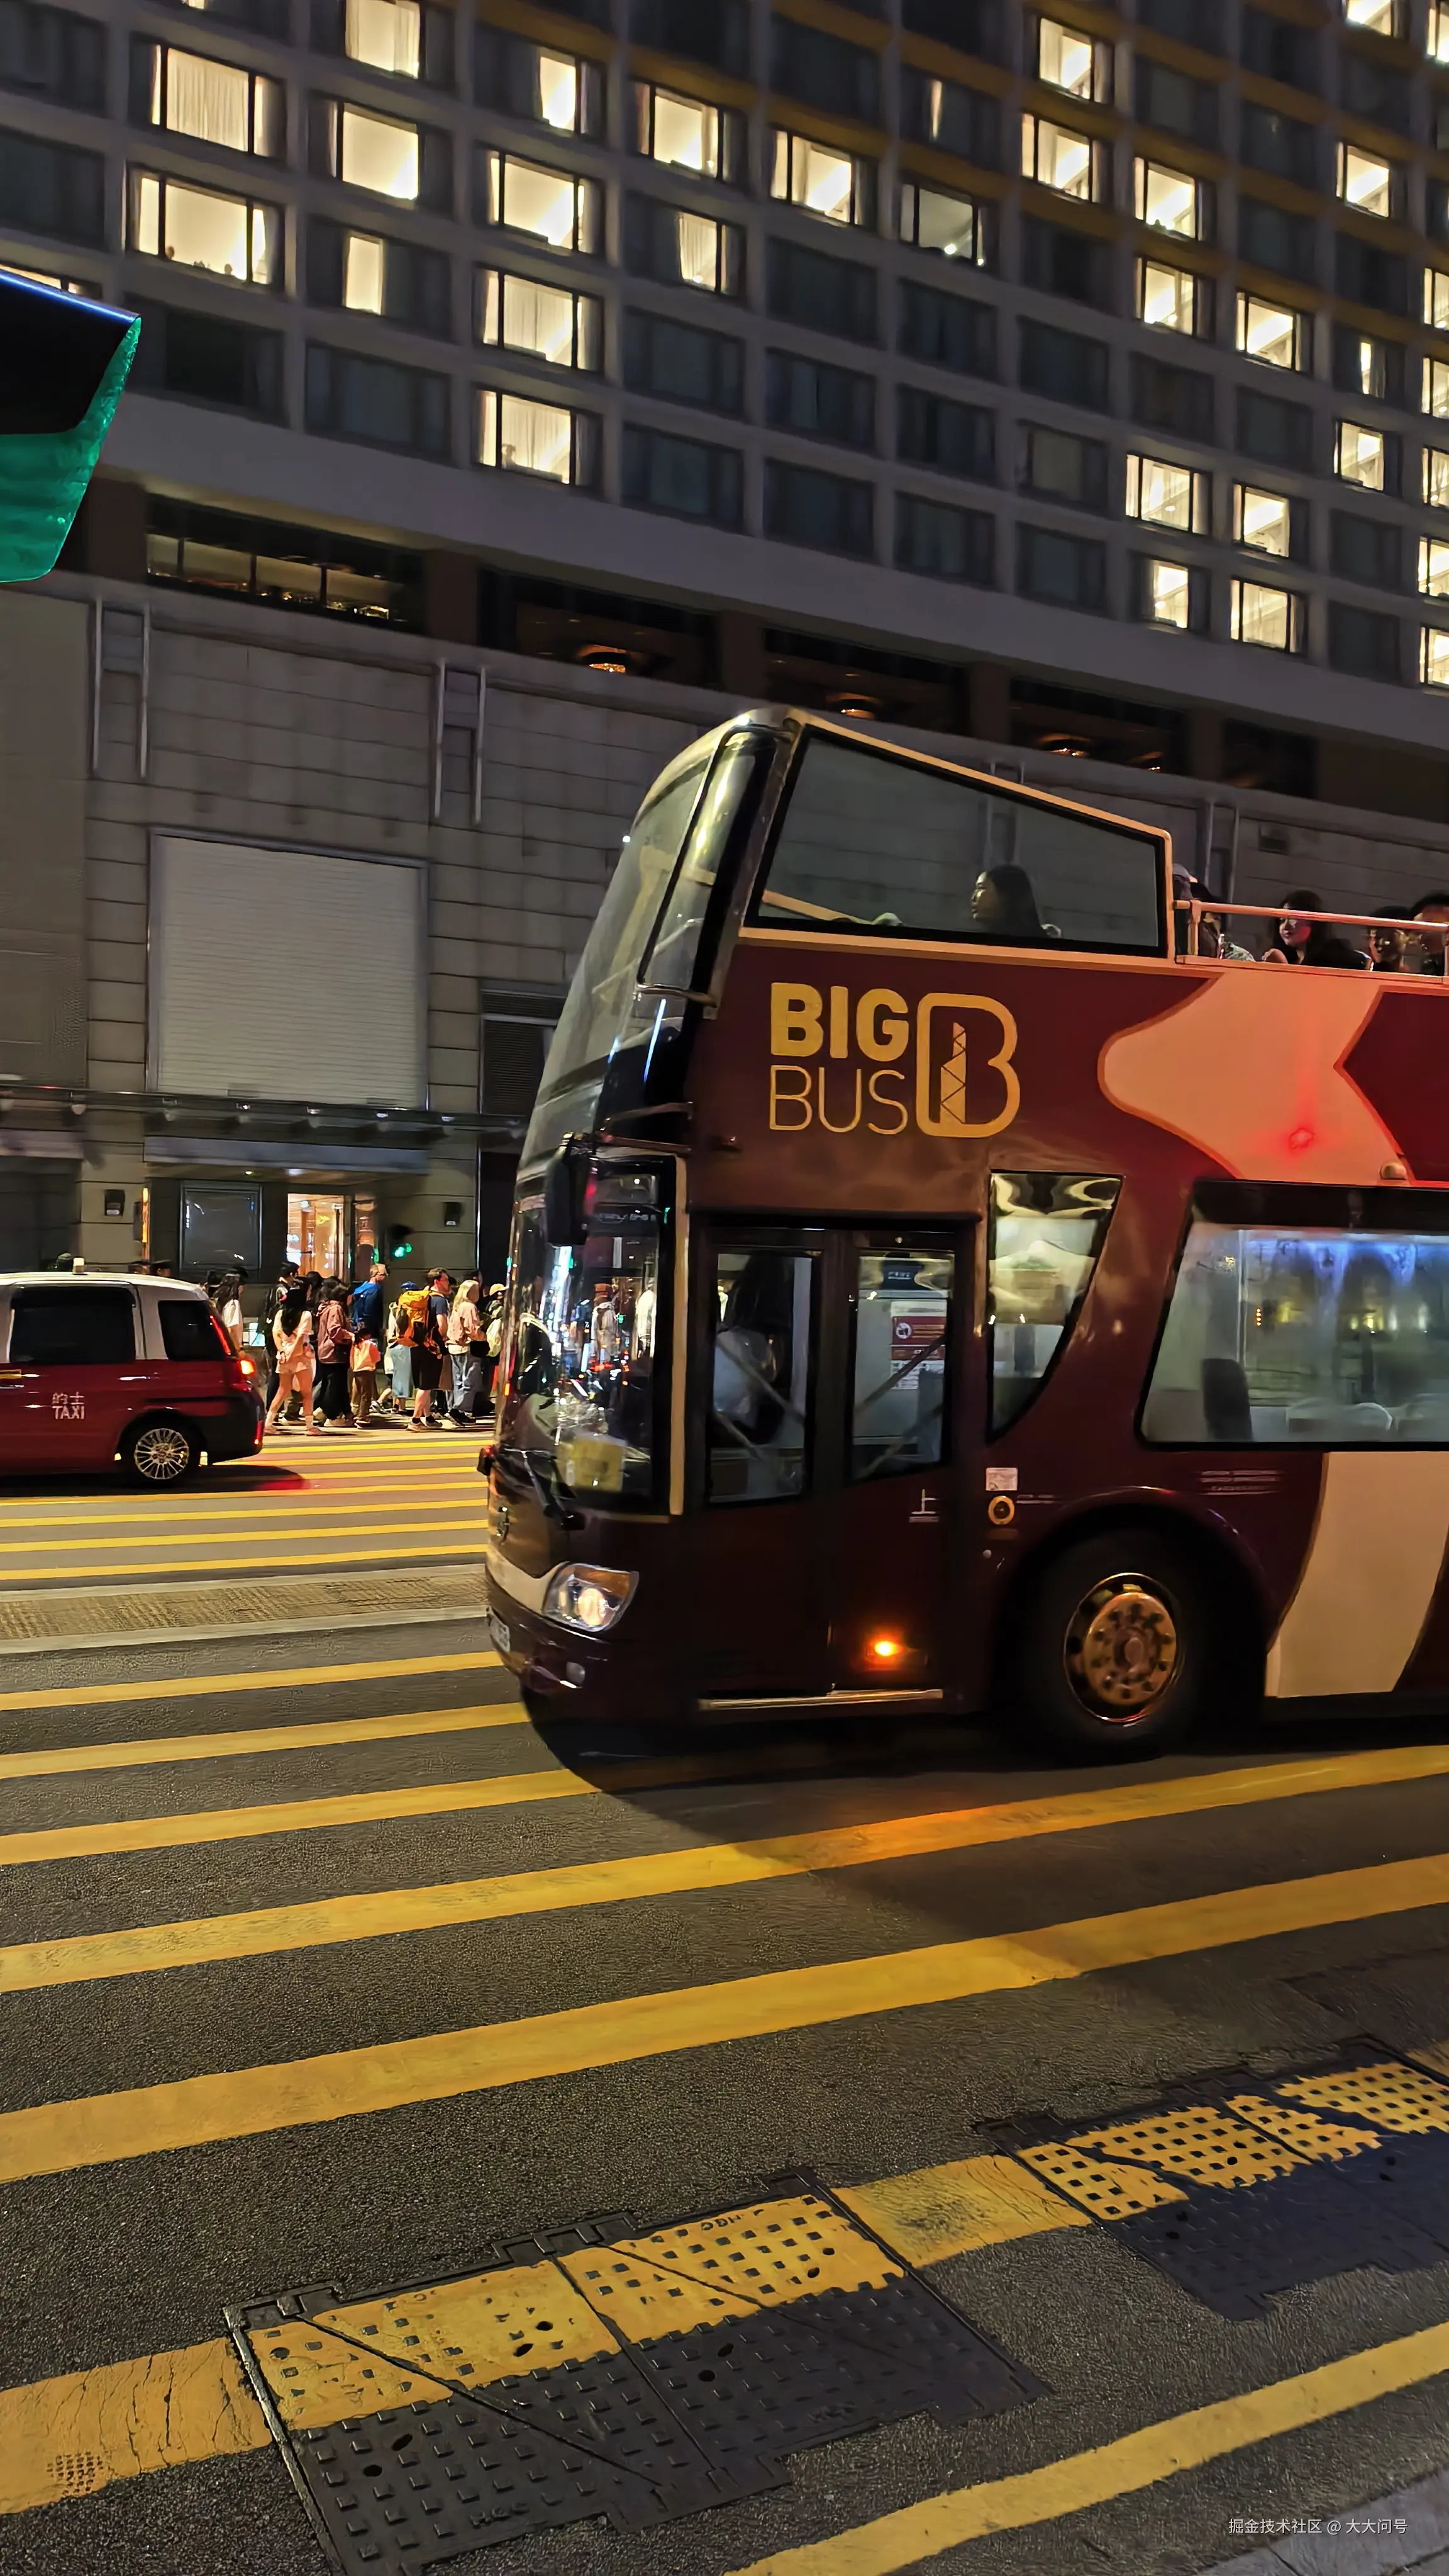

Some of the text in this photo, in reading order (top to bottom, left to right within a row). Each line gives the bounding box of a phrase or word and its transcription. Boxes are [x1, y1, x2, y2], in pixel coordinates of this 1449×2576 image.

[770, 982, 909, 1062] BIG
[769, 1065, 909, 1135] BUS
[52, 1391, 85, 1405] 的士
[52, 1405, 85, 1419] TAXI
[910, 1488, 938, 1514] 上
